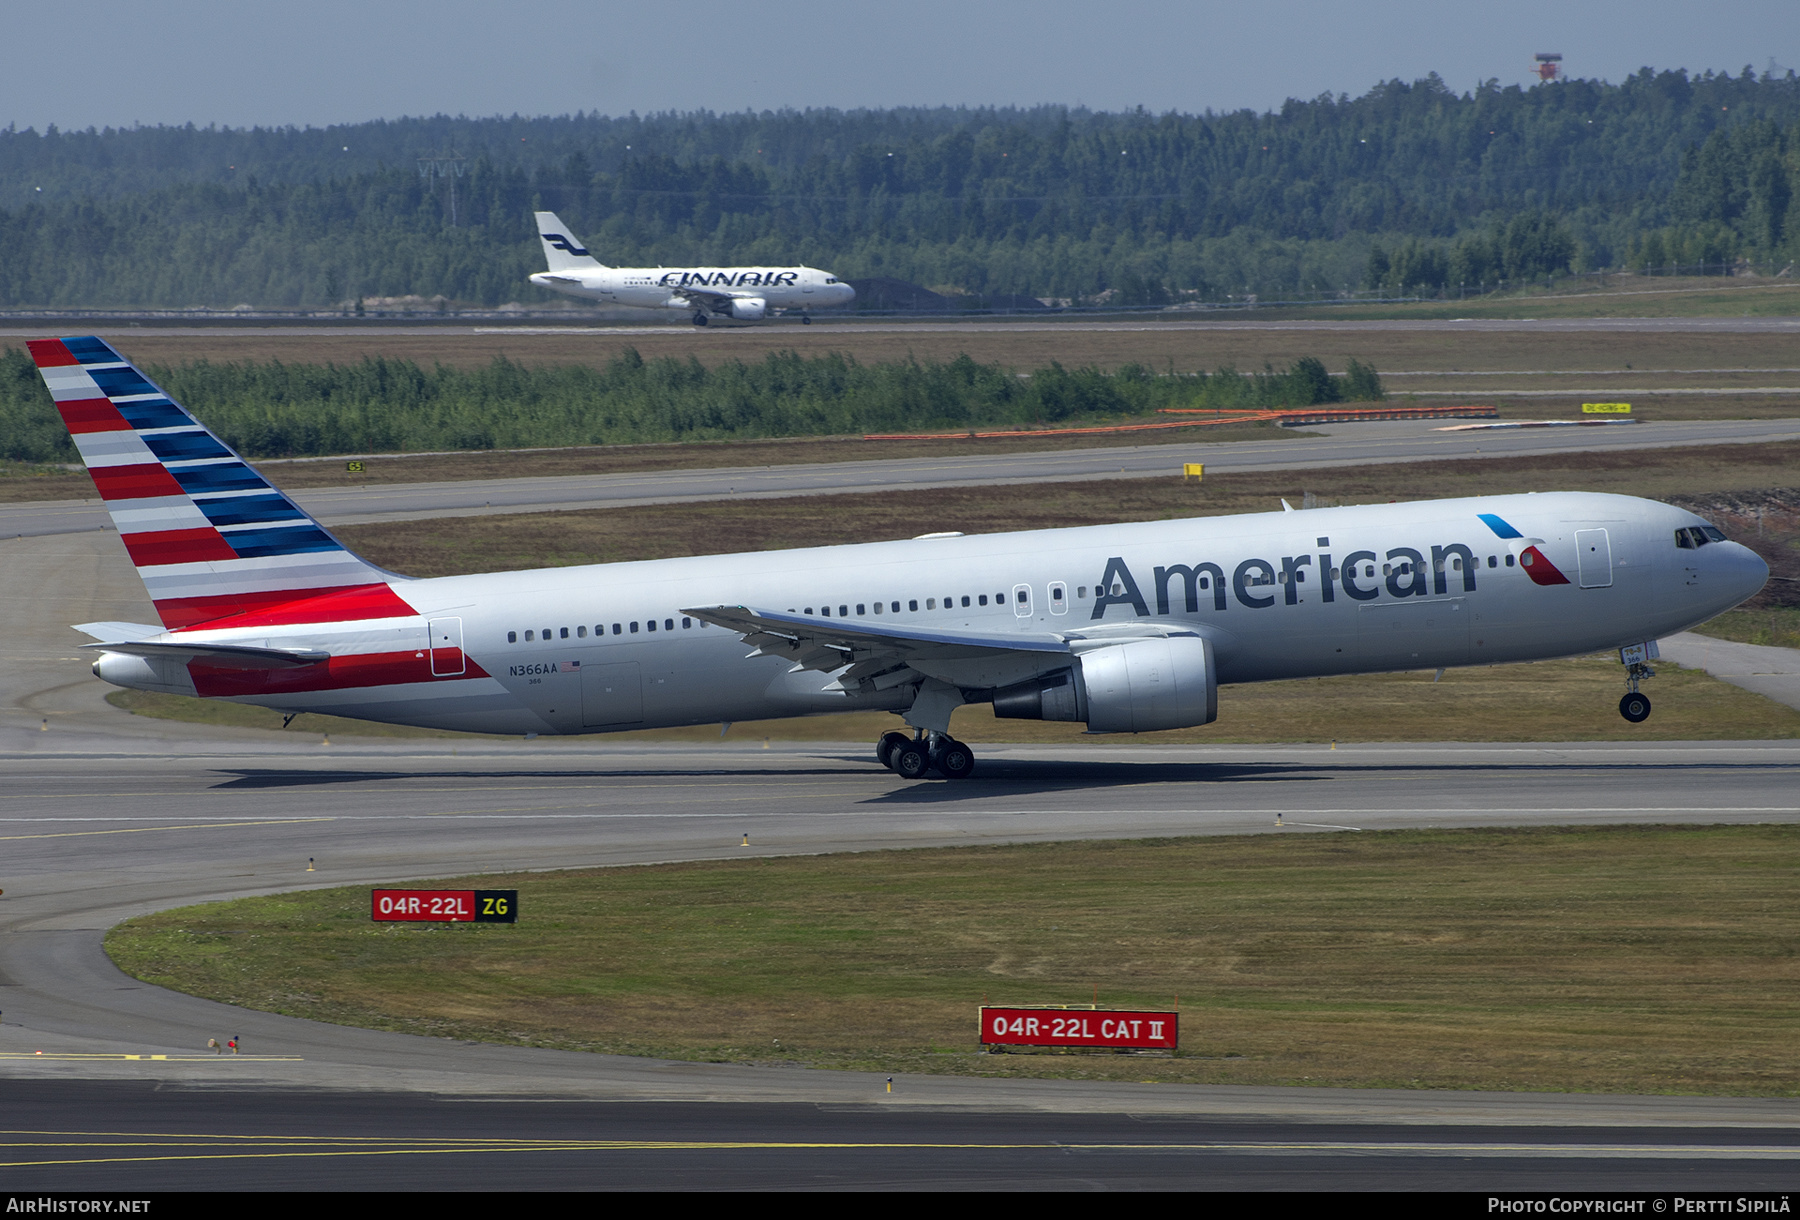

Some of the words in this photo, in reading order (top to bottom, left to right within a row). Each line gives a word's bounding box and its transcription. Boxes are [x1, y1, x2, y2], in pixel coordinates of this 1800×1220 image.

[658, 272, 799, 286] FINNAIR
[1090, 537, 1478, 620] American
[1627, 656, 1640, 664] 366
[509, 663, 558, 677] N366AA
[379, 897, 468, 914] 04R-22L
[482, 898, 508, 915] ZG
[993, 1017, 1095, 1038] 04R-22L
[1101, 1019, 1142, 1039] CAT
